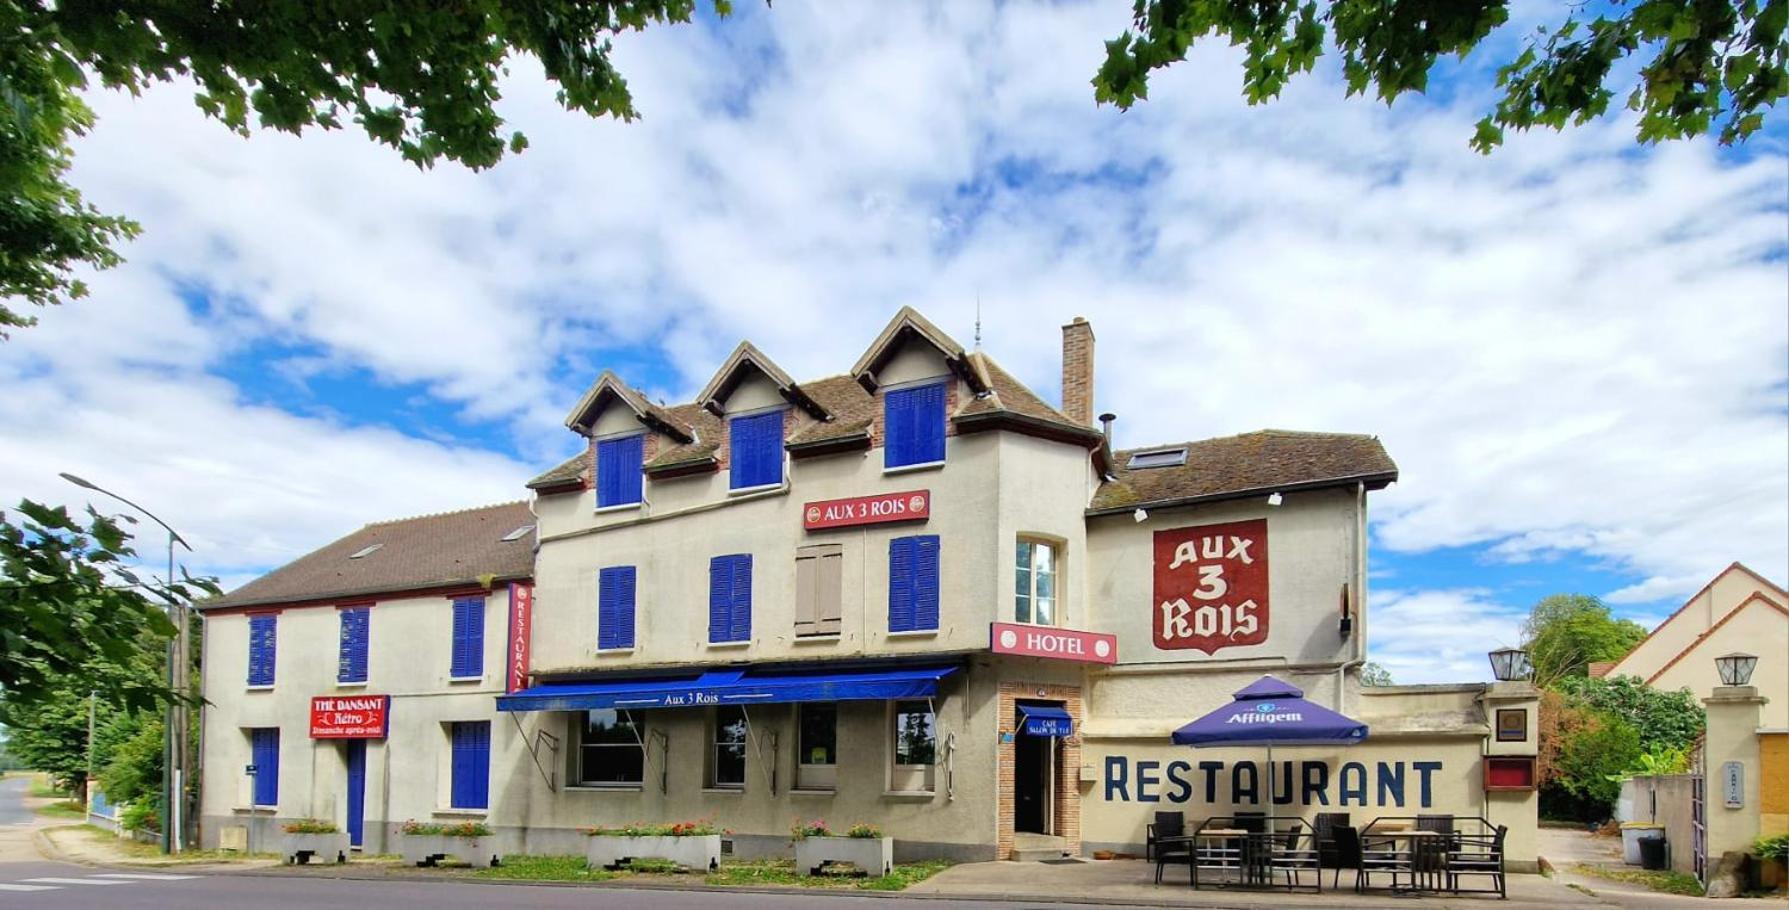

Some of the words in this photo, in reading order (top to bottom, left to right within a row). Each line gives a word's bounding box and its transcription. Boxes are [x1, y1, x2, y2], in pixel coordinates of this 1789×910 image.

[824, 504, 855, 521] AUX
[859, 503, 867, 517] 3
[871, 499, 905, 517] ROIS
[1168, 535, 1254, 570] AUX
[1192, 564, 1228, 600] 3
[514, 601, 525, 687] RESTAURANT
[1027, 633, 1085, 655] HOTEL
[337, 698, 383, 711] DANSANT
[664, 693, 685, 706] Aux
[687, 692, 694, 705] 3
[696, 692, 719, 704] Rois
[1225, 712, 1303, 724] Affligem
[1104, 755, 1443, 809] RESTAURANT
